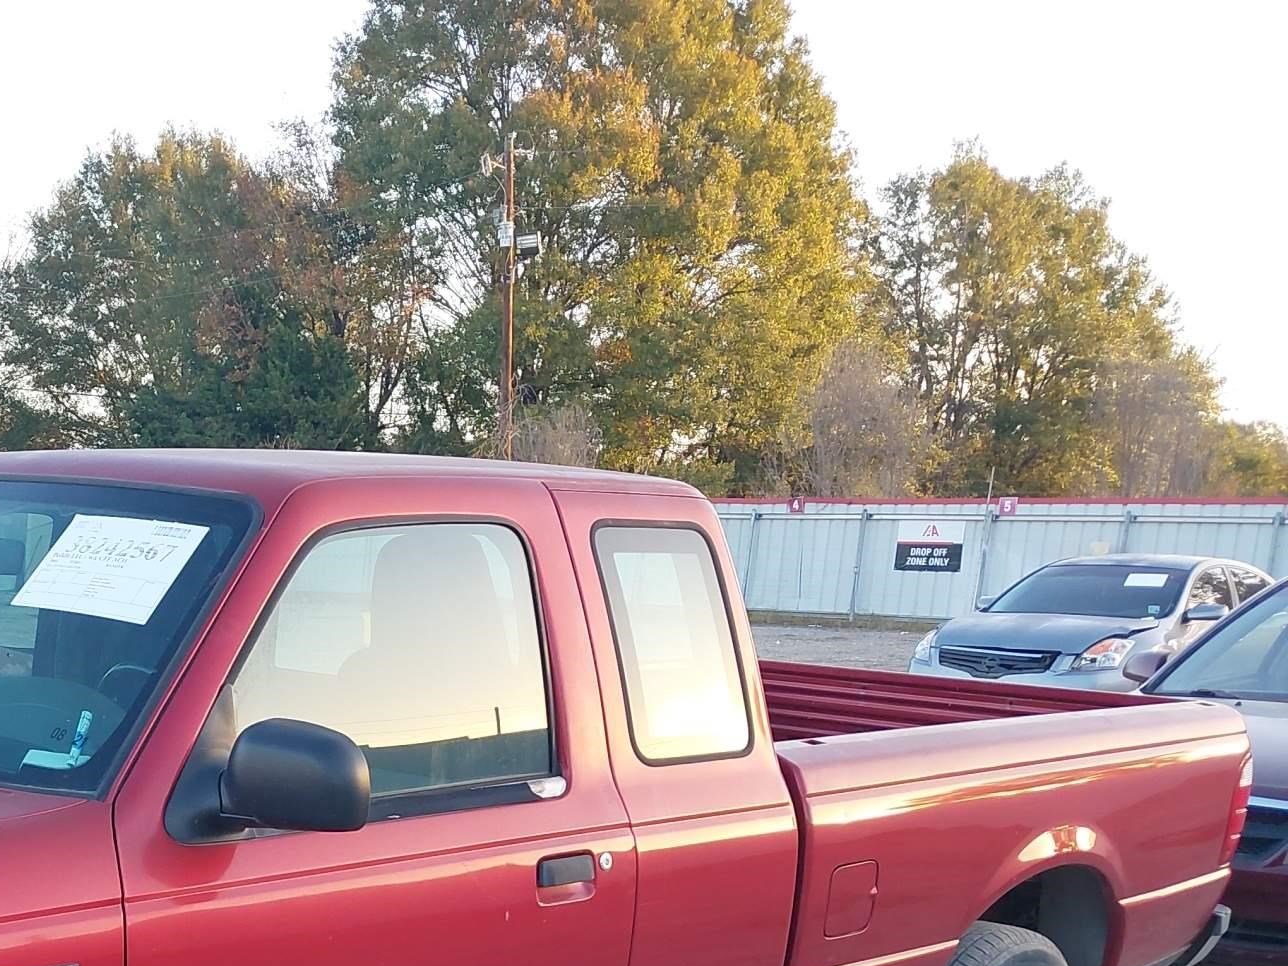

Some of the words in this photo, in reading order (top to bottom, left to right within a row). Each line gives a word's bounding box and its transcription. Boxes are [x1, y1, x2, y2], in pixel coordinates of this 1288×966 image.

[792, 501, 800, 511] 4
[1003, 502, 1012, 512] 5
[65, 535, 180, 563] 38242567
[910, 547, 932, 557] DROP
[933, 547, 948, 557] OFF
[905, 556, 928, 566] ZONE
[928, 557, 950, 567] ONLY
